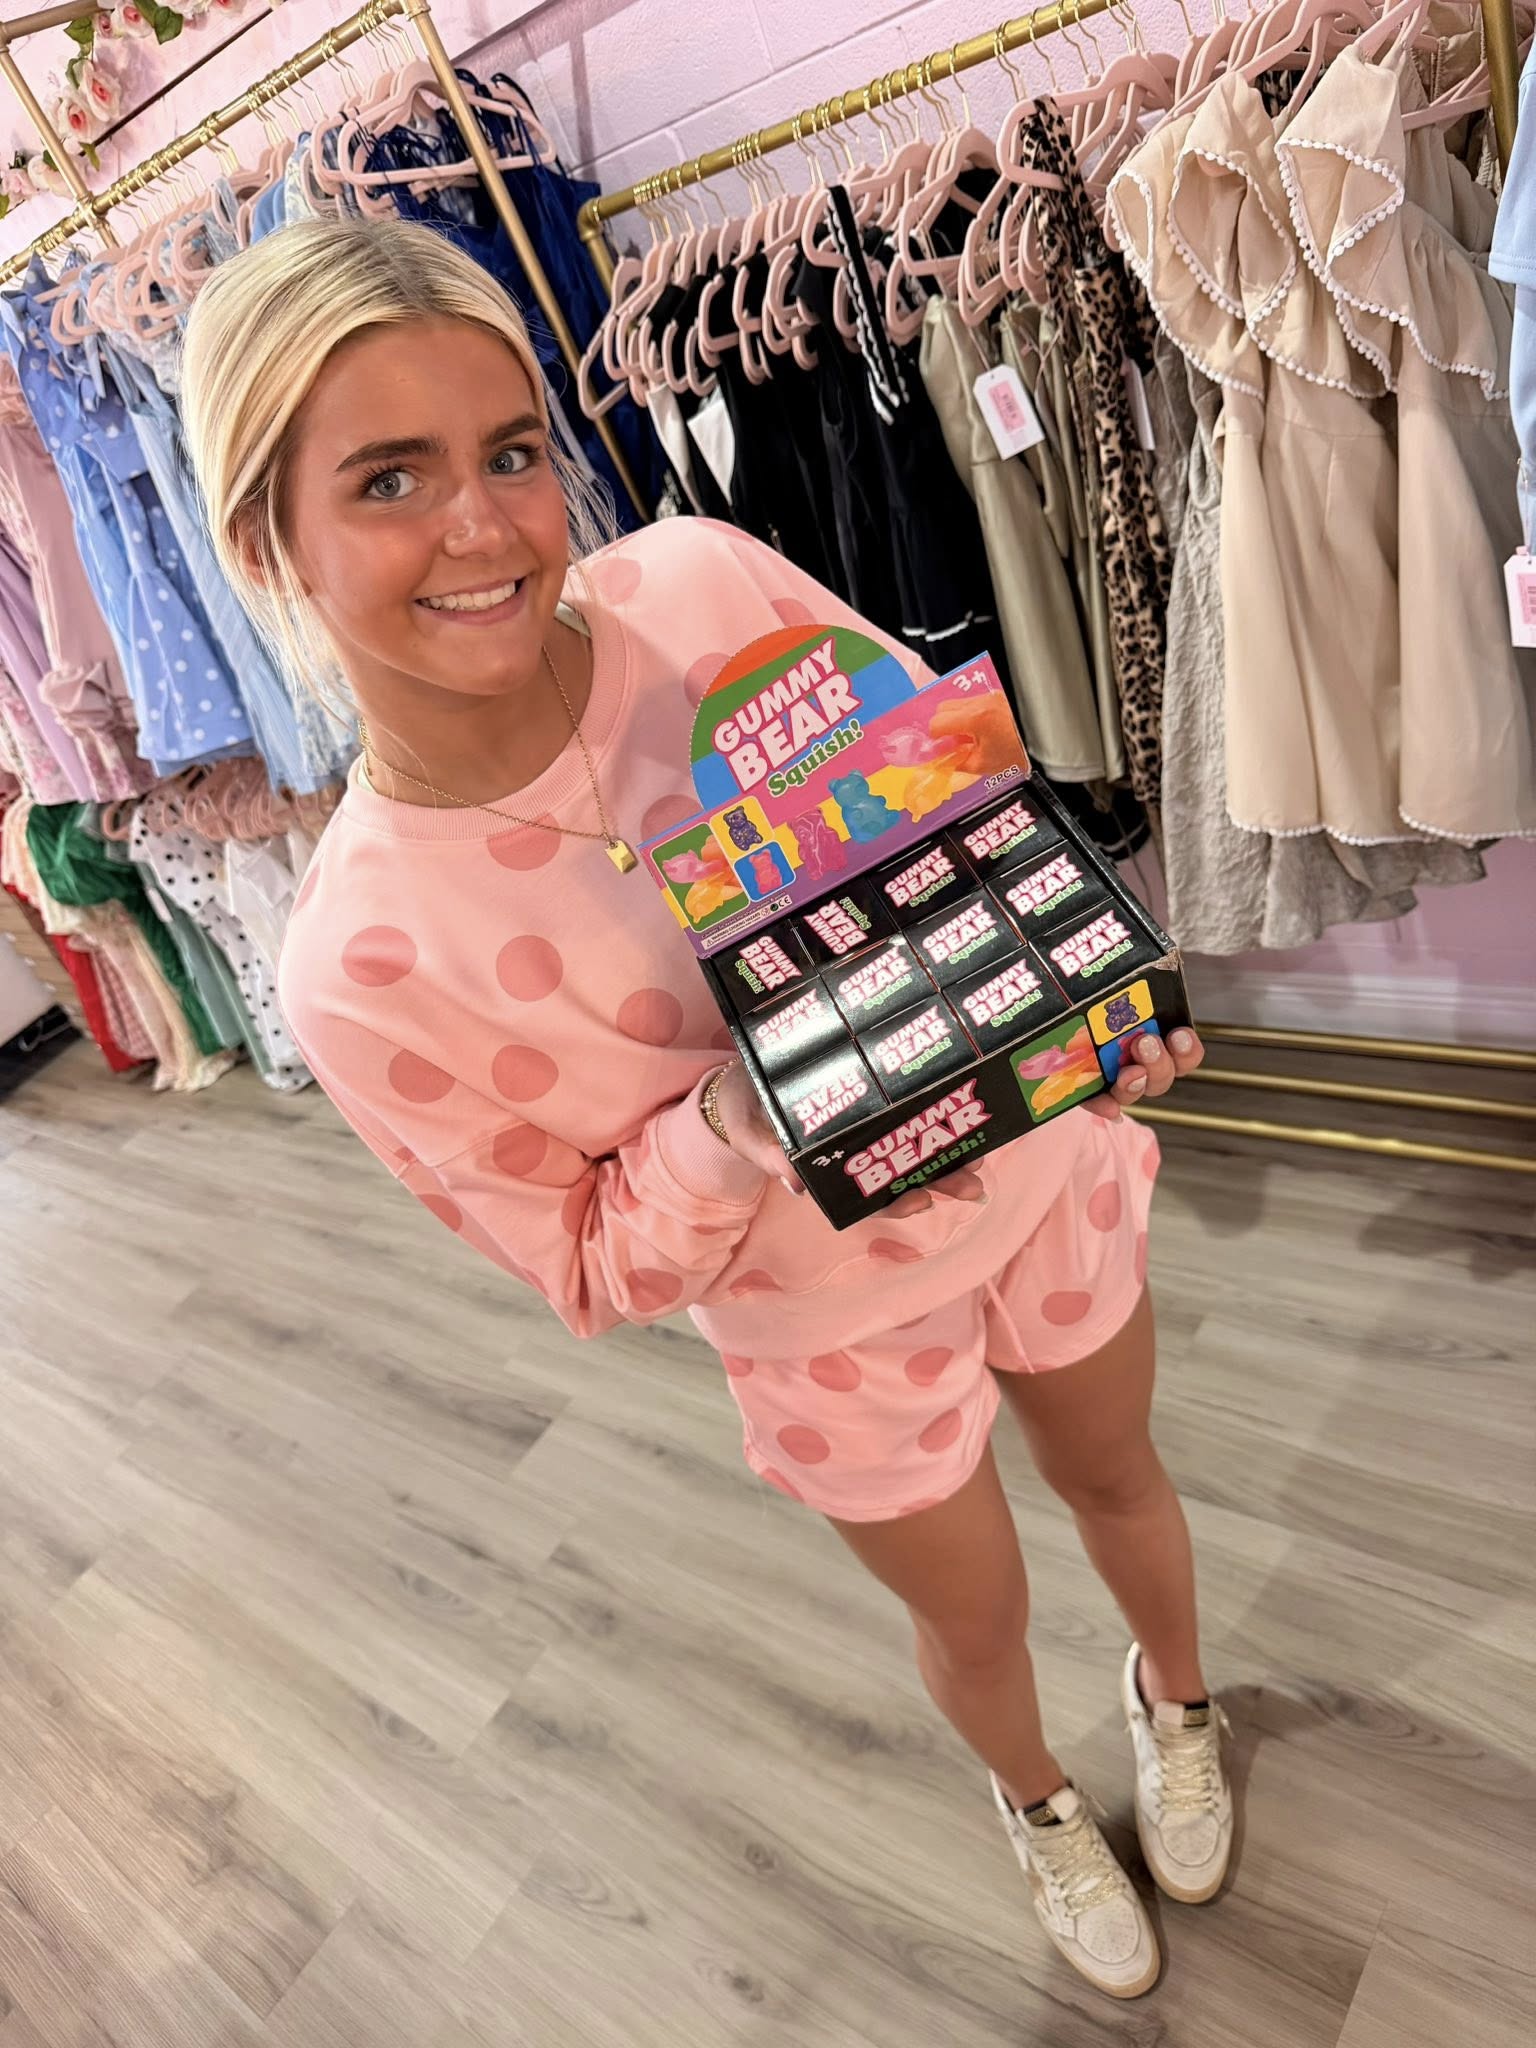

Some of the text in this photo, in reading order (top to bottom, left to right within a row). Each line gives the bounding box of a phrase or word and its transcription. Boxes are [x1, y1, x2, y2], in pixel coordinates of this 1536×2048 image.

[713, 638, 834, 752] GUMMY
[953, 670, 986, 691] 3+
[727, 673, 862, 792] BEAR
[767, 719, 863, 797] Squish!
[984, 765, 1019, 789] 12PCS
[964, 801, 1022, 846] GUMMY
[970, 811, 1035, 860] BEAR
[989, 825, 1037, 859] Squish!
[884, 846, 942, 893] GUMMY
[890, 857, 955, 907] BEAR
[909, 872, 956, 907] Squish!
[1006, 853, 1067, 902] GUMMY
[1013, 864, 1082, 916] BEAR
[840, 897, 871, 930] Squish!
[1033, 880, 1084, 916] Squish!
[803, 912, 847, 954] GUMMY
[818, 900, 868, 947] BEAR
[922, 901, 984, 949] GUMMY
[928, 912, 997, 964] BEAR
[1050, 910, 1114, 960] GUMMY
[739, 943, 786, 991] BEAR
[758, 936, 802, 980] GUMMY
[838, 946, 899, 994] GUMMY
[1057, 922, 1131, 978] BEAR
[1080, 940, 1133, 978] Squish!
[844, 957, 912, 1008] BEAR
[962, 959, 1027, 1010] GUMMY
[969, 971, 1042, 1026] BEAR
[756, 989, 816, 1038] GUMMY
[875, 1005, 938, 1057] GUMMY
[990, 990, 1043, 1027] Squish!
[881, 1018, 952, 1075] BEAR
[803, 1081, 869, 1136] GUMMY
[846, 1078, 976, 1175] GUMMY
[811, 1149, 845, 1167] 3+
[856, 1100, 991, 1196] BEAR
[890, 1131, 987, 1194] Squish!
